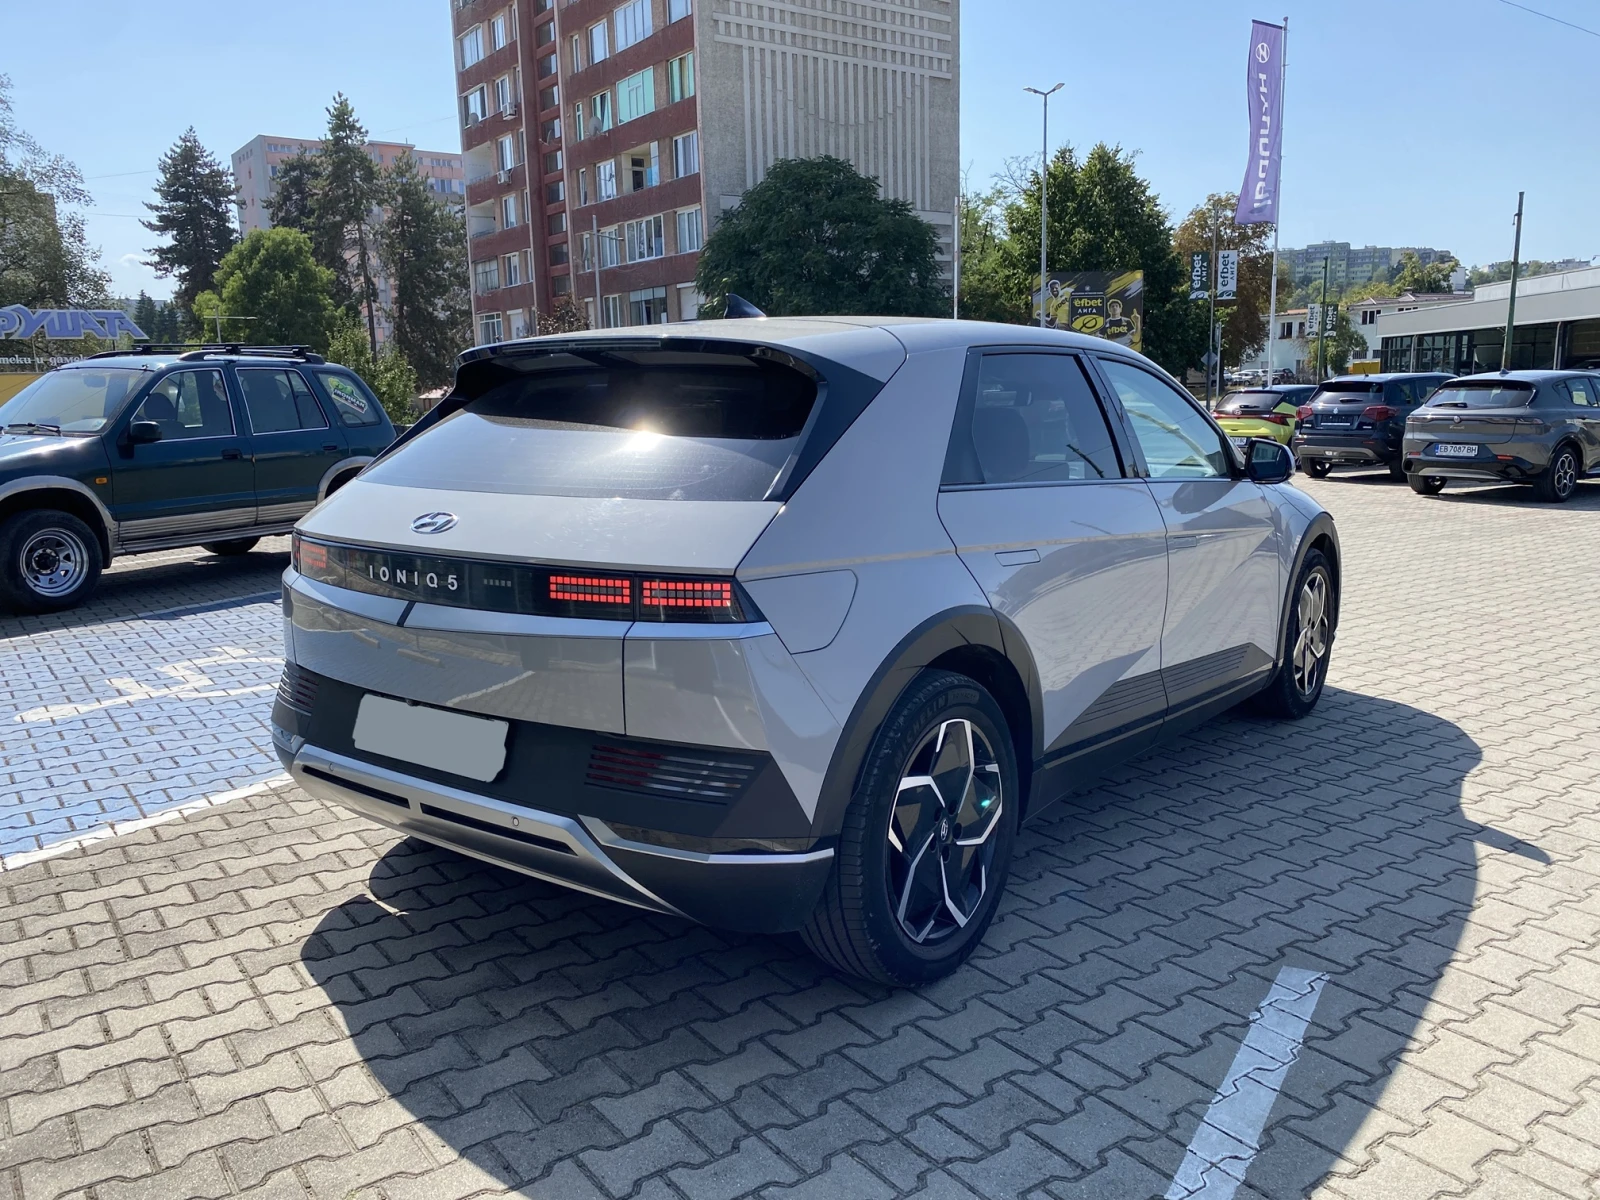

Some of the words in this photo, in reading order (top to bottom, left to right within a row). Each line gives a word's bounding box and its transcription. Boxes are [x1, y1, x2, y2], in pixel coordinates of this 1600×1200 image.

[1192, 254, 1202, 289] efbet
[1220, 253, 1230, 287] efbet
[1073, 298, 1102, 307] efbet
[1107, 326, 1128, 335] efbet
[369, 565, 438, 588] IONIQ
[447, 575, 458, 591] 5
